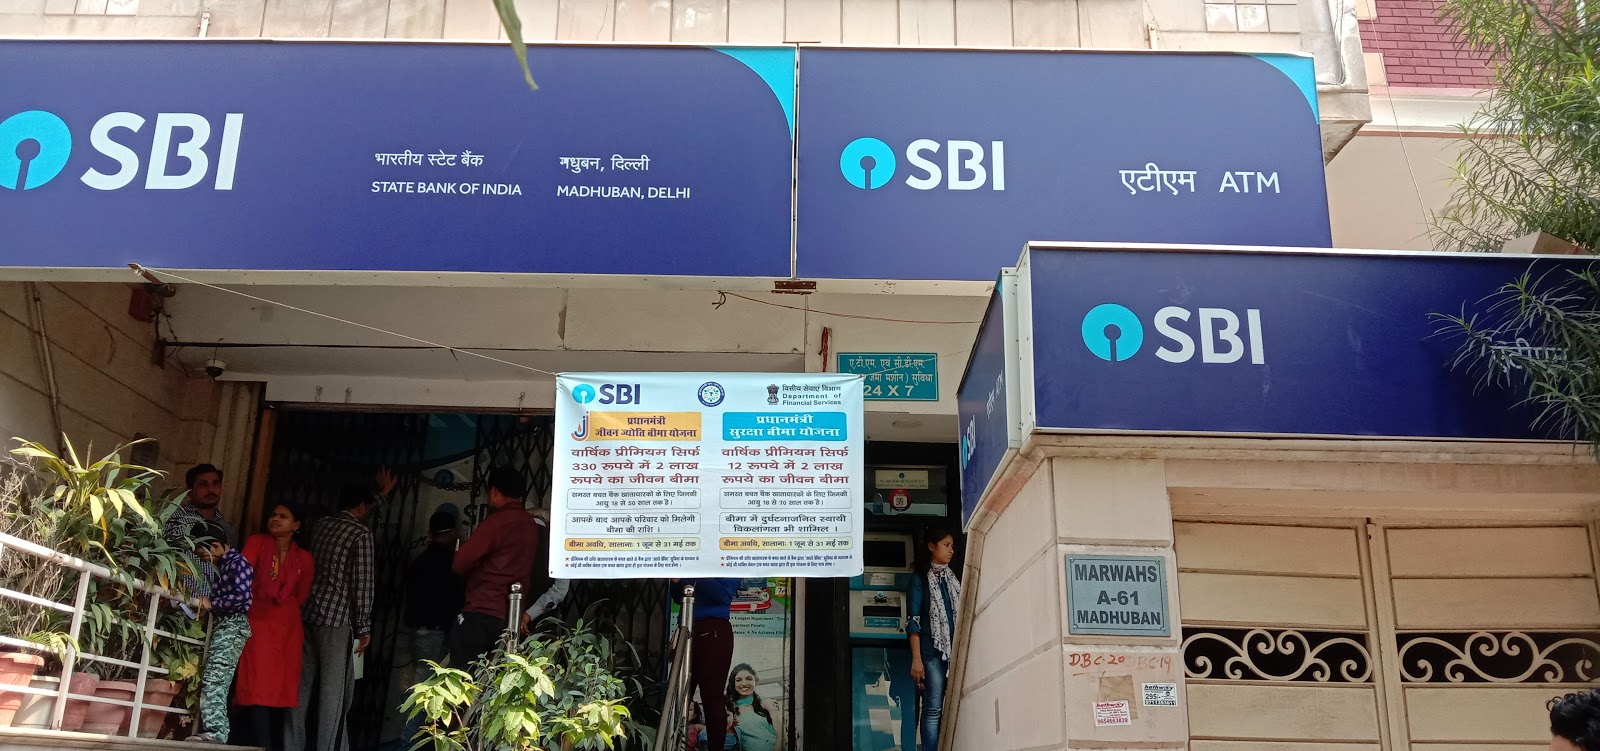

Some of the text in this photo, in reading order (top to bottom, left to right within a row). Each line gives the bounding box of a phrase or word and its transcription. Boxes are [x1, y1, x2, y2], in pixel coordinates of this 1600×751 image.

[80, 111, 244, 191] SBI
[374, 150, 485, 167] भारतीय स्टेट बैंक
[611, 155, 650, 171] दिल्ली
[905, 138, 1005, 191] SBI
[1118, 162, 1197, 195] एटीएम
[1218, 171, 1281, 194] ATM
[371, 181, 522, 196] STATE BANK OF INDIA
[556, 185, 691, 199] MADHUBAN, DELHI
[1153, 306, 1265, 365] SBI
[599, 384, 640, 404] SBI
[863, 385, 914, 396] 24 X 7
[627, 415, 666, 425] प्रधानमंत्री
[756, 413, 813, 425] प्रधानमंत्री
[595, 427, 697, 438] जीवन ज्योति बीमा योजना
[729, 426, 840, 438] सुरक्षा बीमा योजना
[571, 446, 700, 457] वार्षिक प्रीमियम सिर्फ
[721, 446, 849, 457] वार्षिक प्रीमियम सिर्फ
[572, 463, 597, 471] 330
[638, 460, 651, 470] में
[656, 462, 664, 470] 2
[669, 462, 700, 470] लाख
[728, 462, 743, 470] 12
[783, 460, 796, 470] में
[801, 462, 809, 470] 2
[813, 462, 843, 470] लाख
[607, 476, 625, 484] का
[629, 473, 665, 484] जीवन
[669, 473, 700, 483] बीमा
[758, 475, 775, 484] का
[779, 473, 815, 484] जीवन
[819, 473, 849, 484] बीमा
[663, 490, 675, 498] लिए
[572, 515, 593, 523] आपके
[611, 515, 632, 523] आपके
[634, 514, 658, 523] परिवार
[660, 514, 669, 522] को
[671, 514, 695, 522] मिलेगी
[725, 514, 746, 522] बीमा
[750, 514, 758, 522] में
[819, 514, 846, 522] स्थायी
[625, 525, 635, 533] की
[638, 525, 653, 533] राशि
[733, 524, 780, 532] विकलांगता
[783, 524, 794, 532] भी
[798, 524, 828, 532] शामिल
[672, 539, 683, 548] मई
[723, 539, 738, 547] बीमा
[825, 539, 836, 547] मई
[1074, 563, 1158, 583] MARWAHS
[1097, 590, 1139, 606] A-61
[1077, 610, 1161, 626] MADHUBAN
